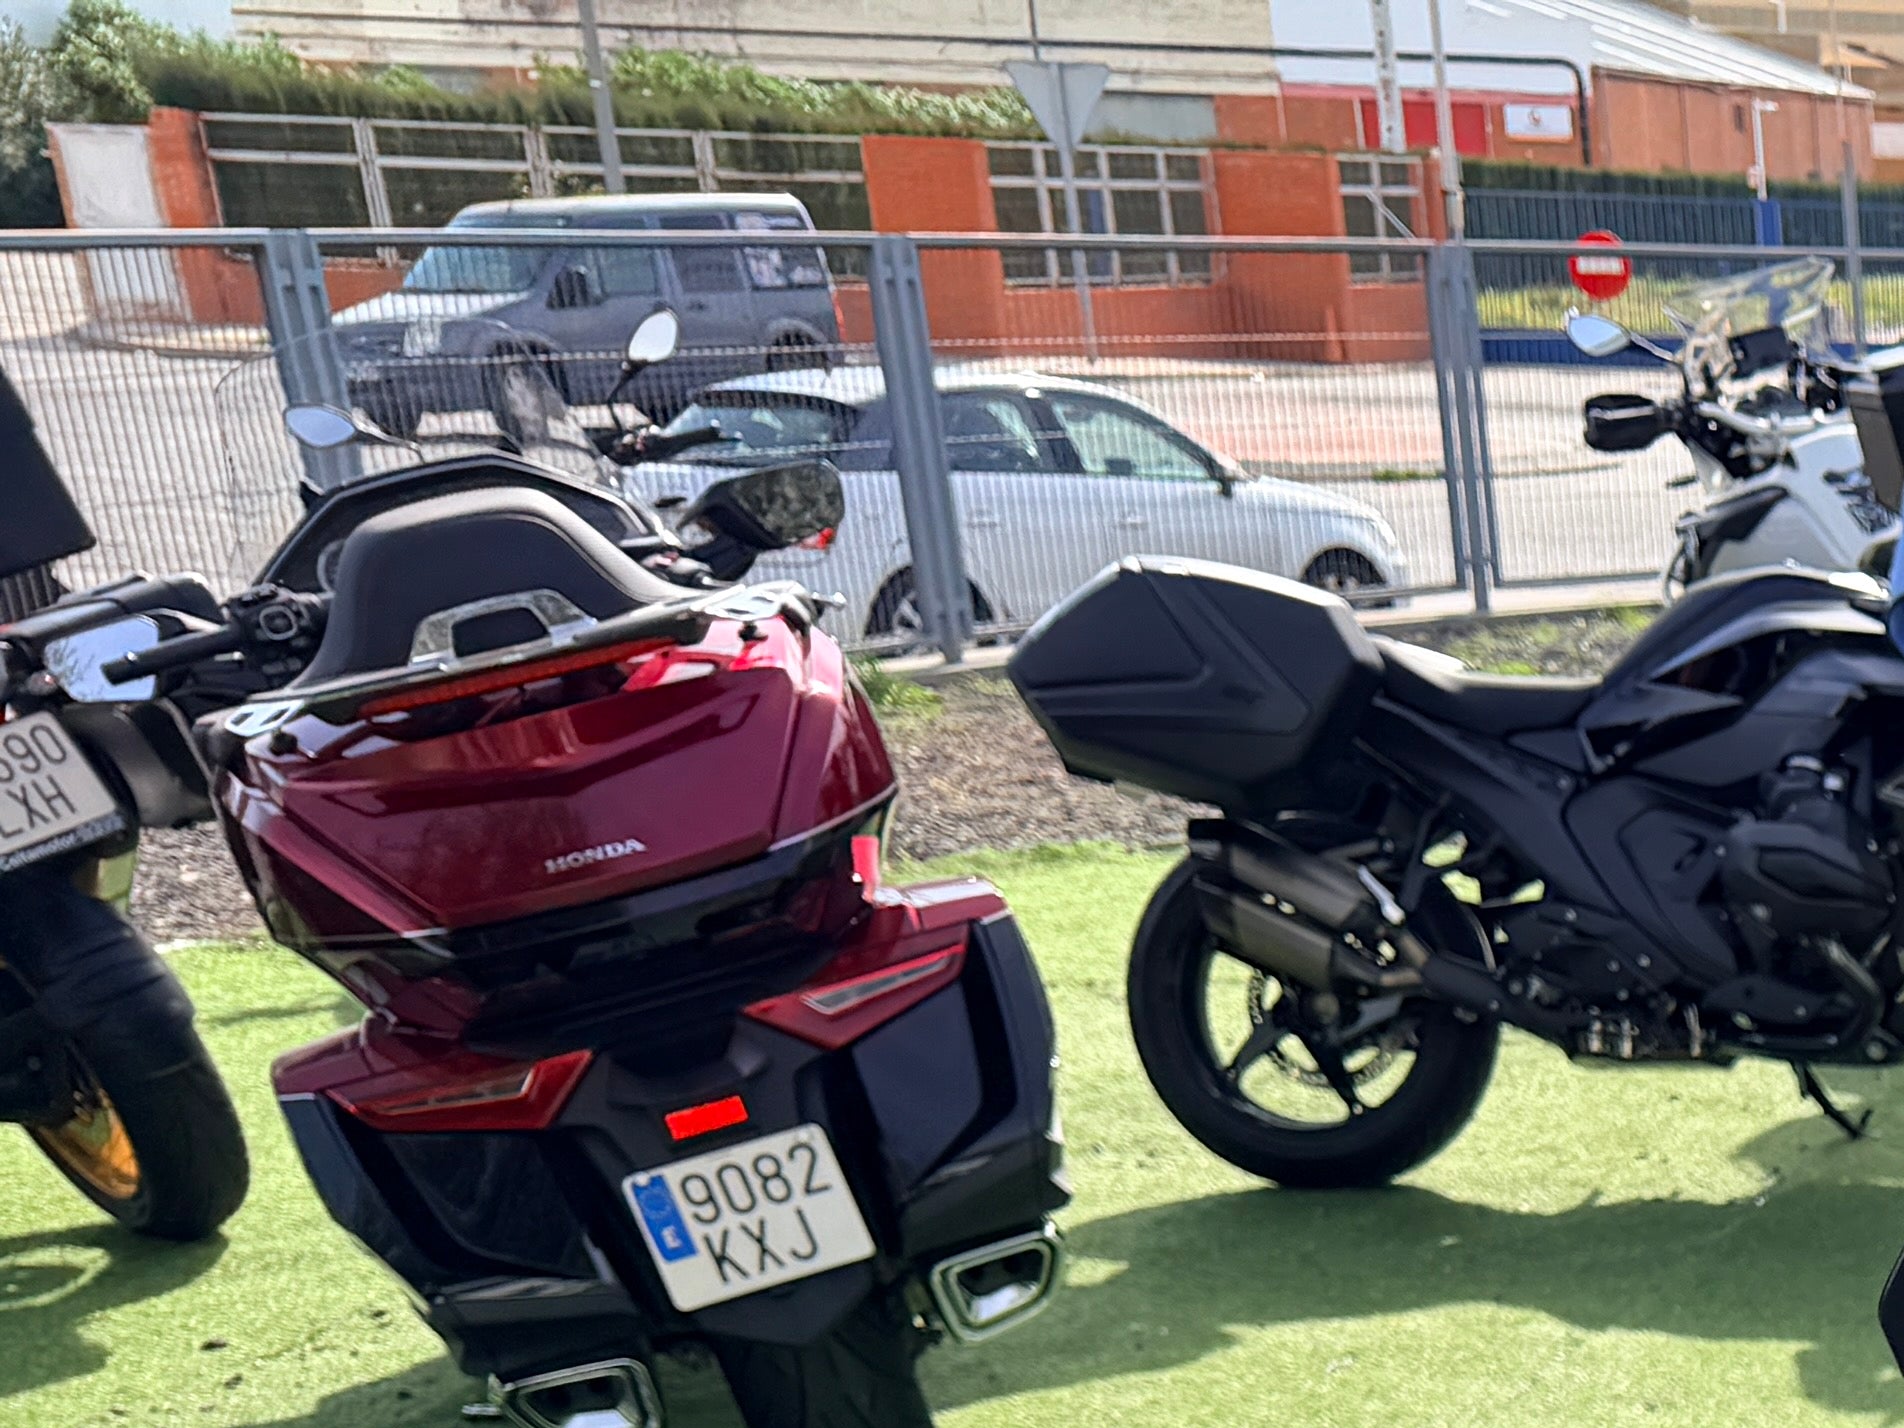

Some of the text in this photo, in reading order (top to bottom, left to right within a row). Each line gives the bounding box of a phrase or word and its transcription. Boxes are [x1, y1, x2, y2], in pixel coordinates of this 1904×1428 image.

[544, 838, 648, 874] HONDA
[680, 1141, 834, 1224] 9082
[703, 1208, 818, 1283] KXJ
